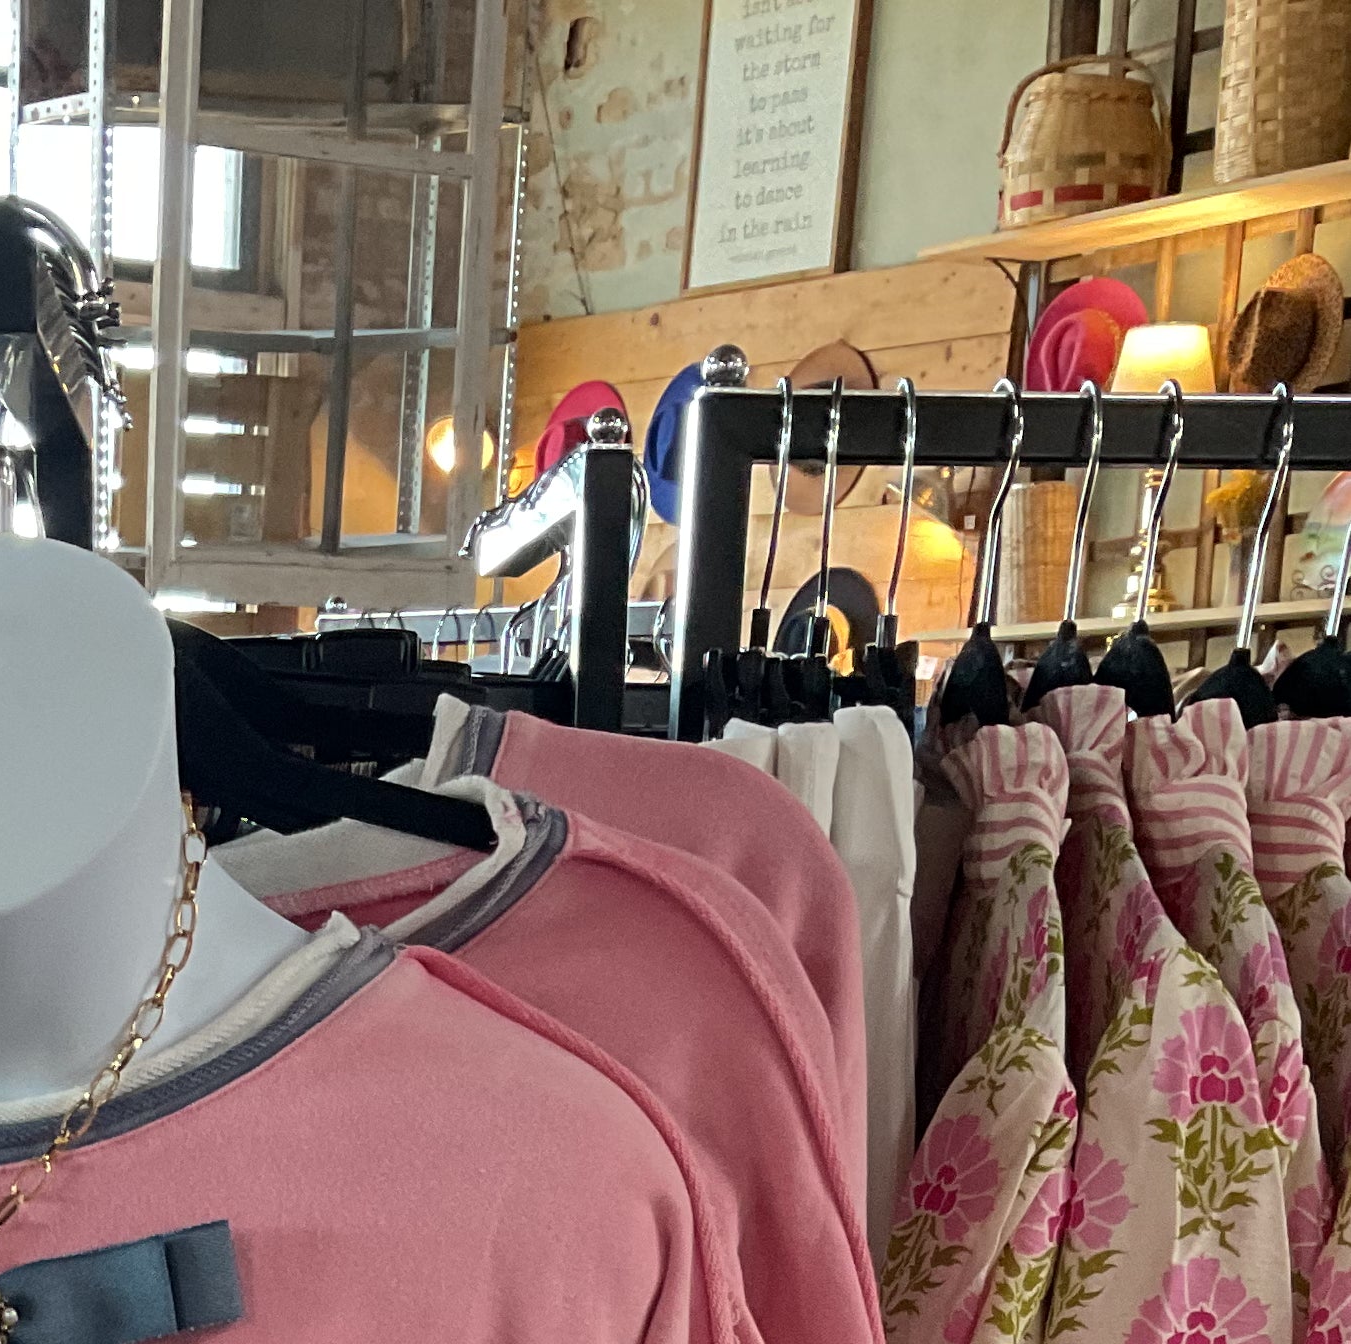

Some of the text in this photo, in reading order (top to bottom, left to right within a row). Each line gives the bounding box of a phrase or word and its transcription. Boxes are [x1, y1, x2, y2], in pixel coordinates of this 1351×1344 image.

[734, 14, 836, 51] waiting for
[743, 50, 820, 82] the storm
[749, 86, 808, 114] to pass
[736, 114, 815, 147] it's about
[733, 150, 811, 178] learning
[735, 183, 803, 210] to dance
[718, 211, 812, 244] in the rain
